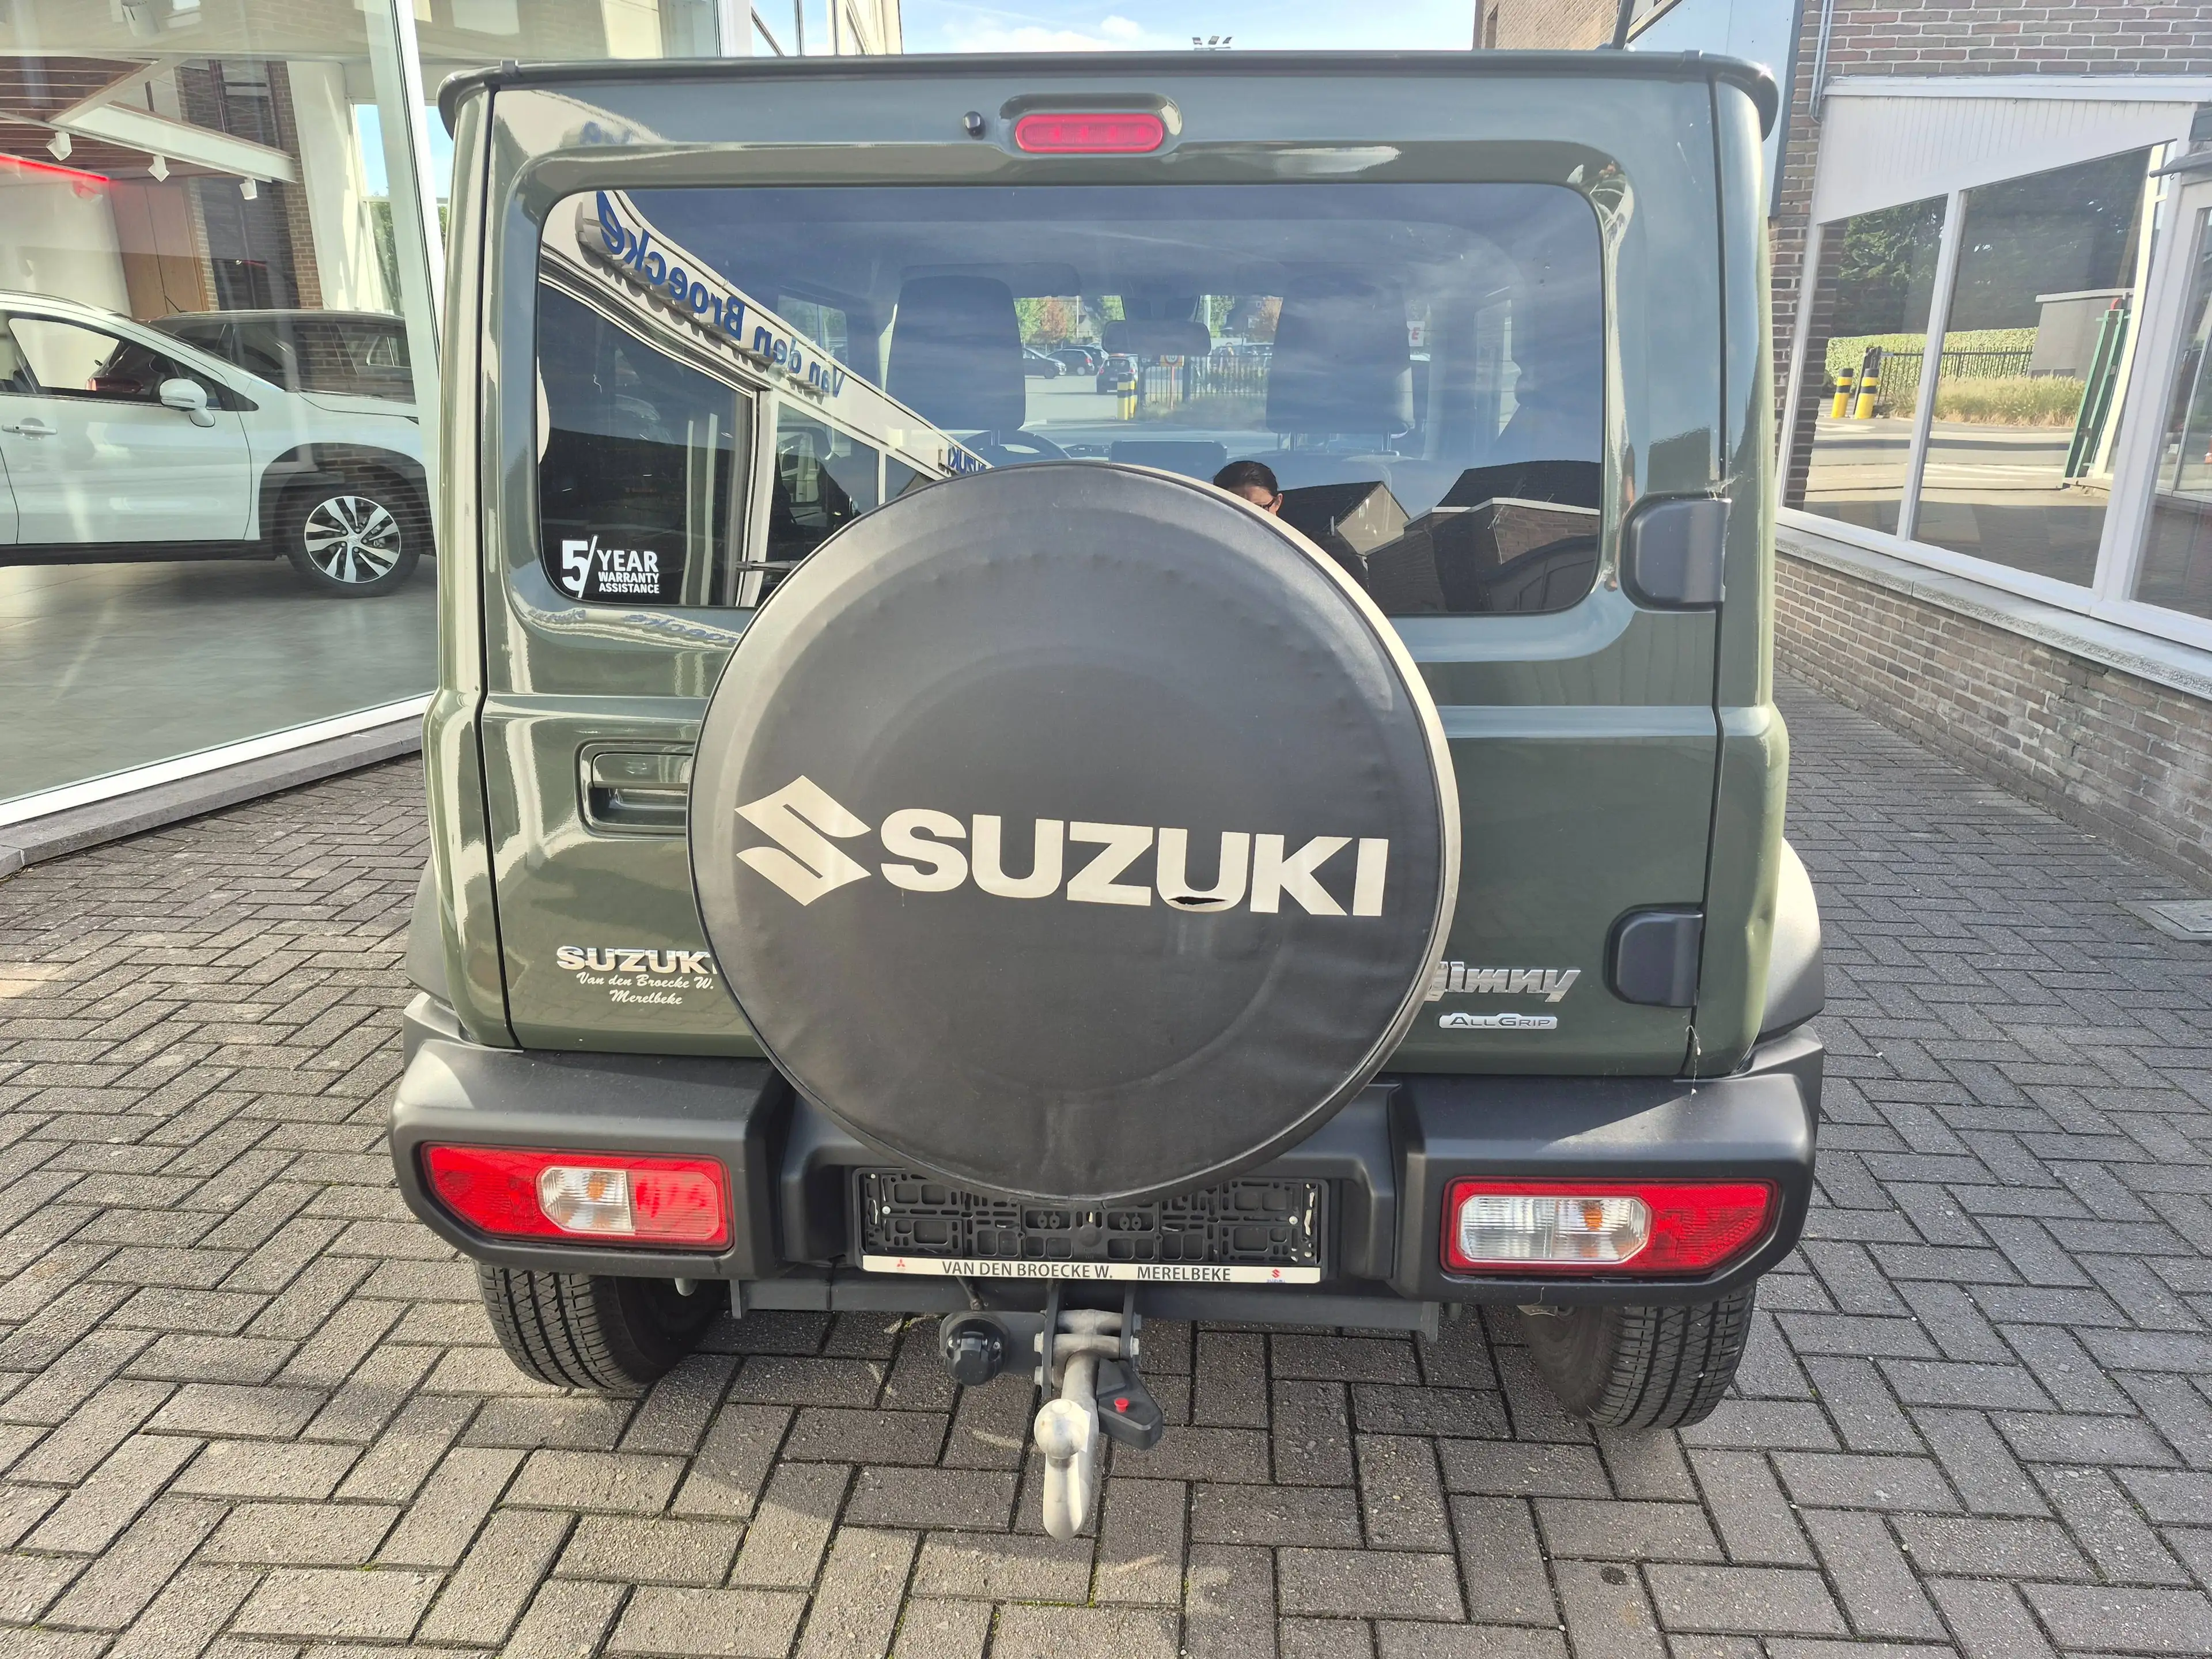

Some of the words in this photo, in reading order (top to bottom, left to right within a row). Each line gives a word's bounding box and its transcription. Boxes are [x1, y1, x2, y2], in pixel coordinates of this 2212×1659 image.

[597, 550, 659, 572] YEAR
[598, 571, 659, 584] WARRANTY
[599, 583, 660, 594] ASSISTANCE
[880, 808, 1389, 917] SUZUKI
[576, 972, 604, 985] Van
[608, 974, 632, 986] den
[636, 974, 690, 989] Broecke
[694, 976, 714, 990] W.
[609, 990, 683, 1005] Merelbeke
[942, 1261, 975, 1275] VAN
[980, 1263, 1012, 1276] DEN
[1017, 1264, 1090, 1278] BROECKE
[1094, 1265, 1113, 1278] W.
[1137, 1266, 1232, 1281] MERELBEKE
